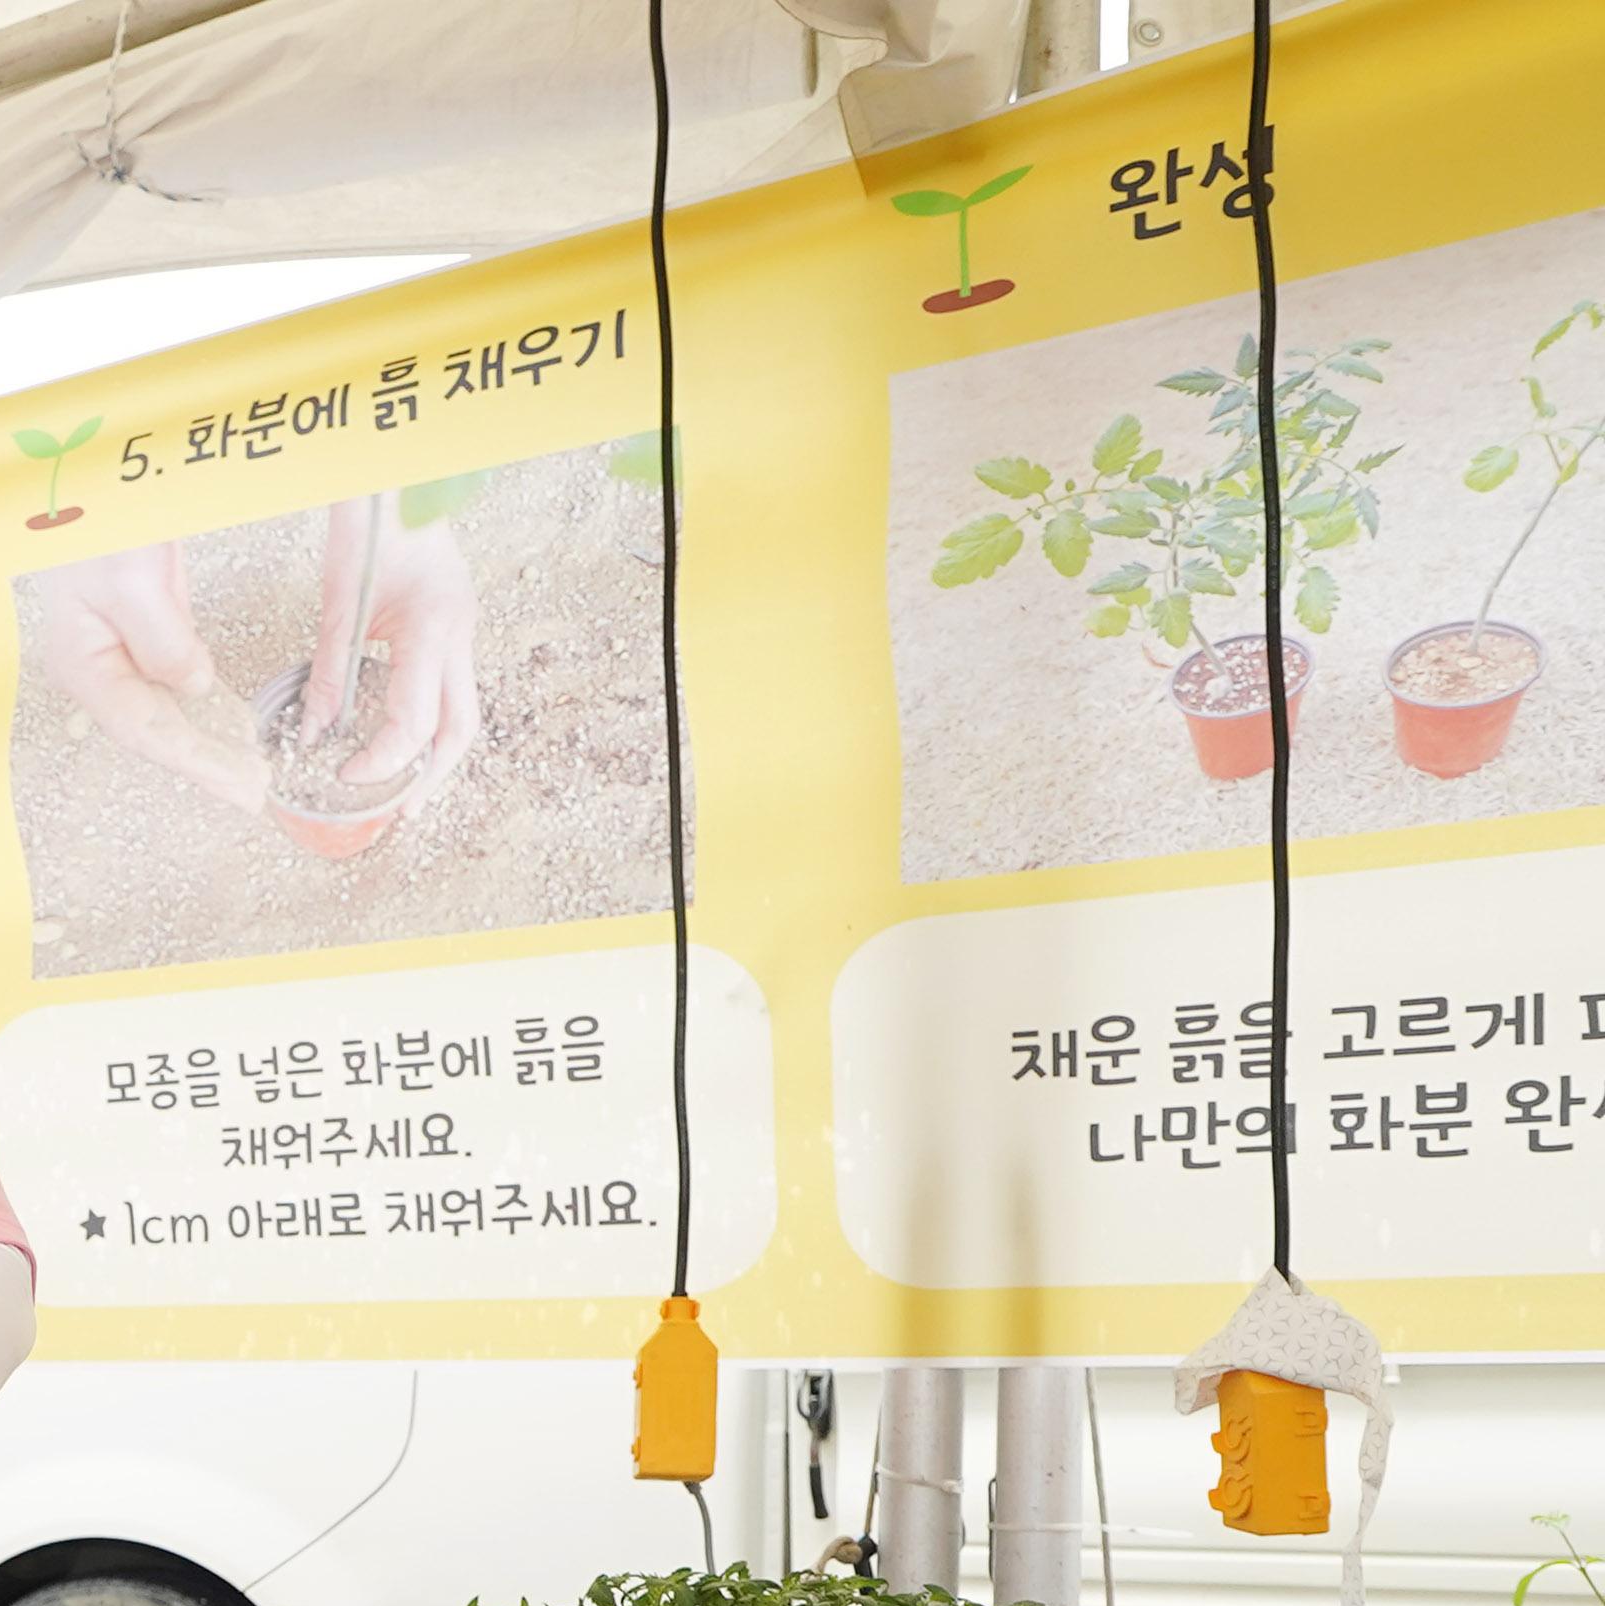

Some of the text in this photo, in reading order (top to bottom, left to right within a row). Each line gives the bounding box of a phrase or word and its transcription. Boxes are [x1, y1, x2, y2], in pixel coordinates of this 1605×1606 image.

[1109, 125, 1275, 241] 완성
[120, 309, 627, 482] 5. 화분에 흙 채우기
[106, 1015, 605, 1110] 모종을 넣은 화분에 흙을
[1011, 1013, 1141, 1086] 채운
[1169, 1002, 1292, 1084] 흙을
[1323, 992, 1545, 1060] 고르게
[221, 1113, 473, 1171] 채워주세요.
[1089, 1075, 1605, 1169] 나만의 화분 완
[125, 1180, 658, 1246] 1cm 아래로 채워주세요.
